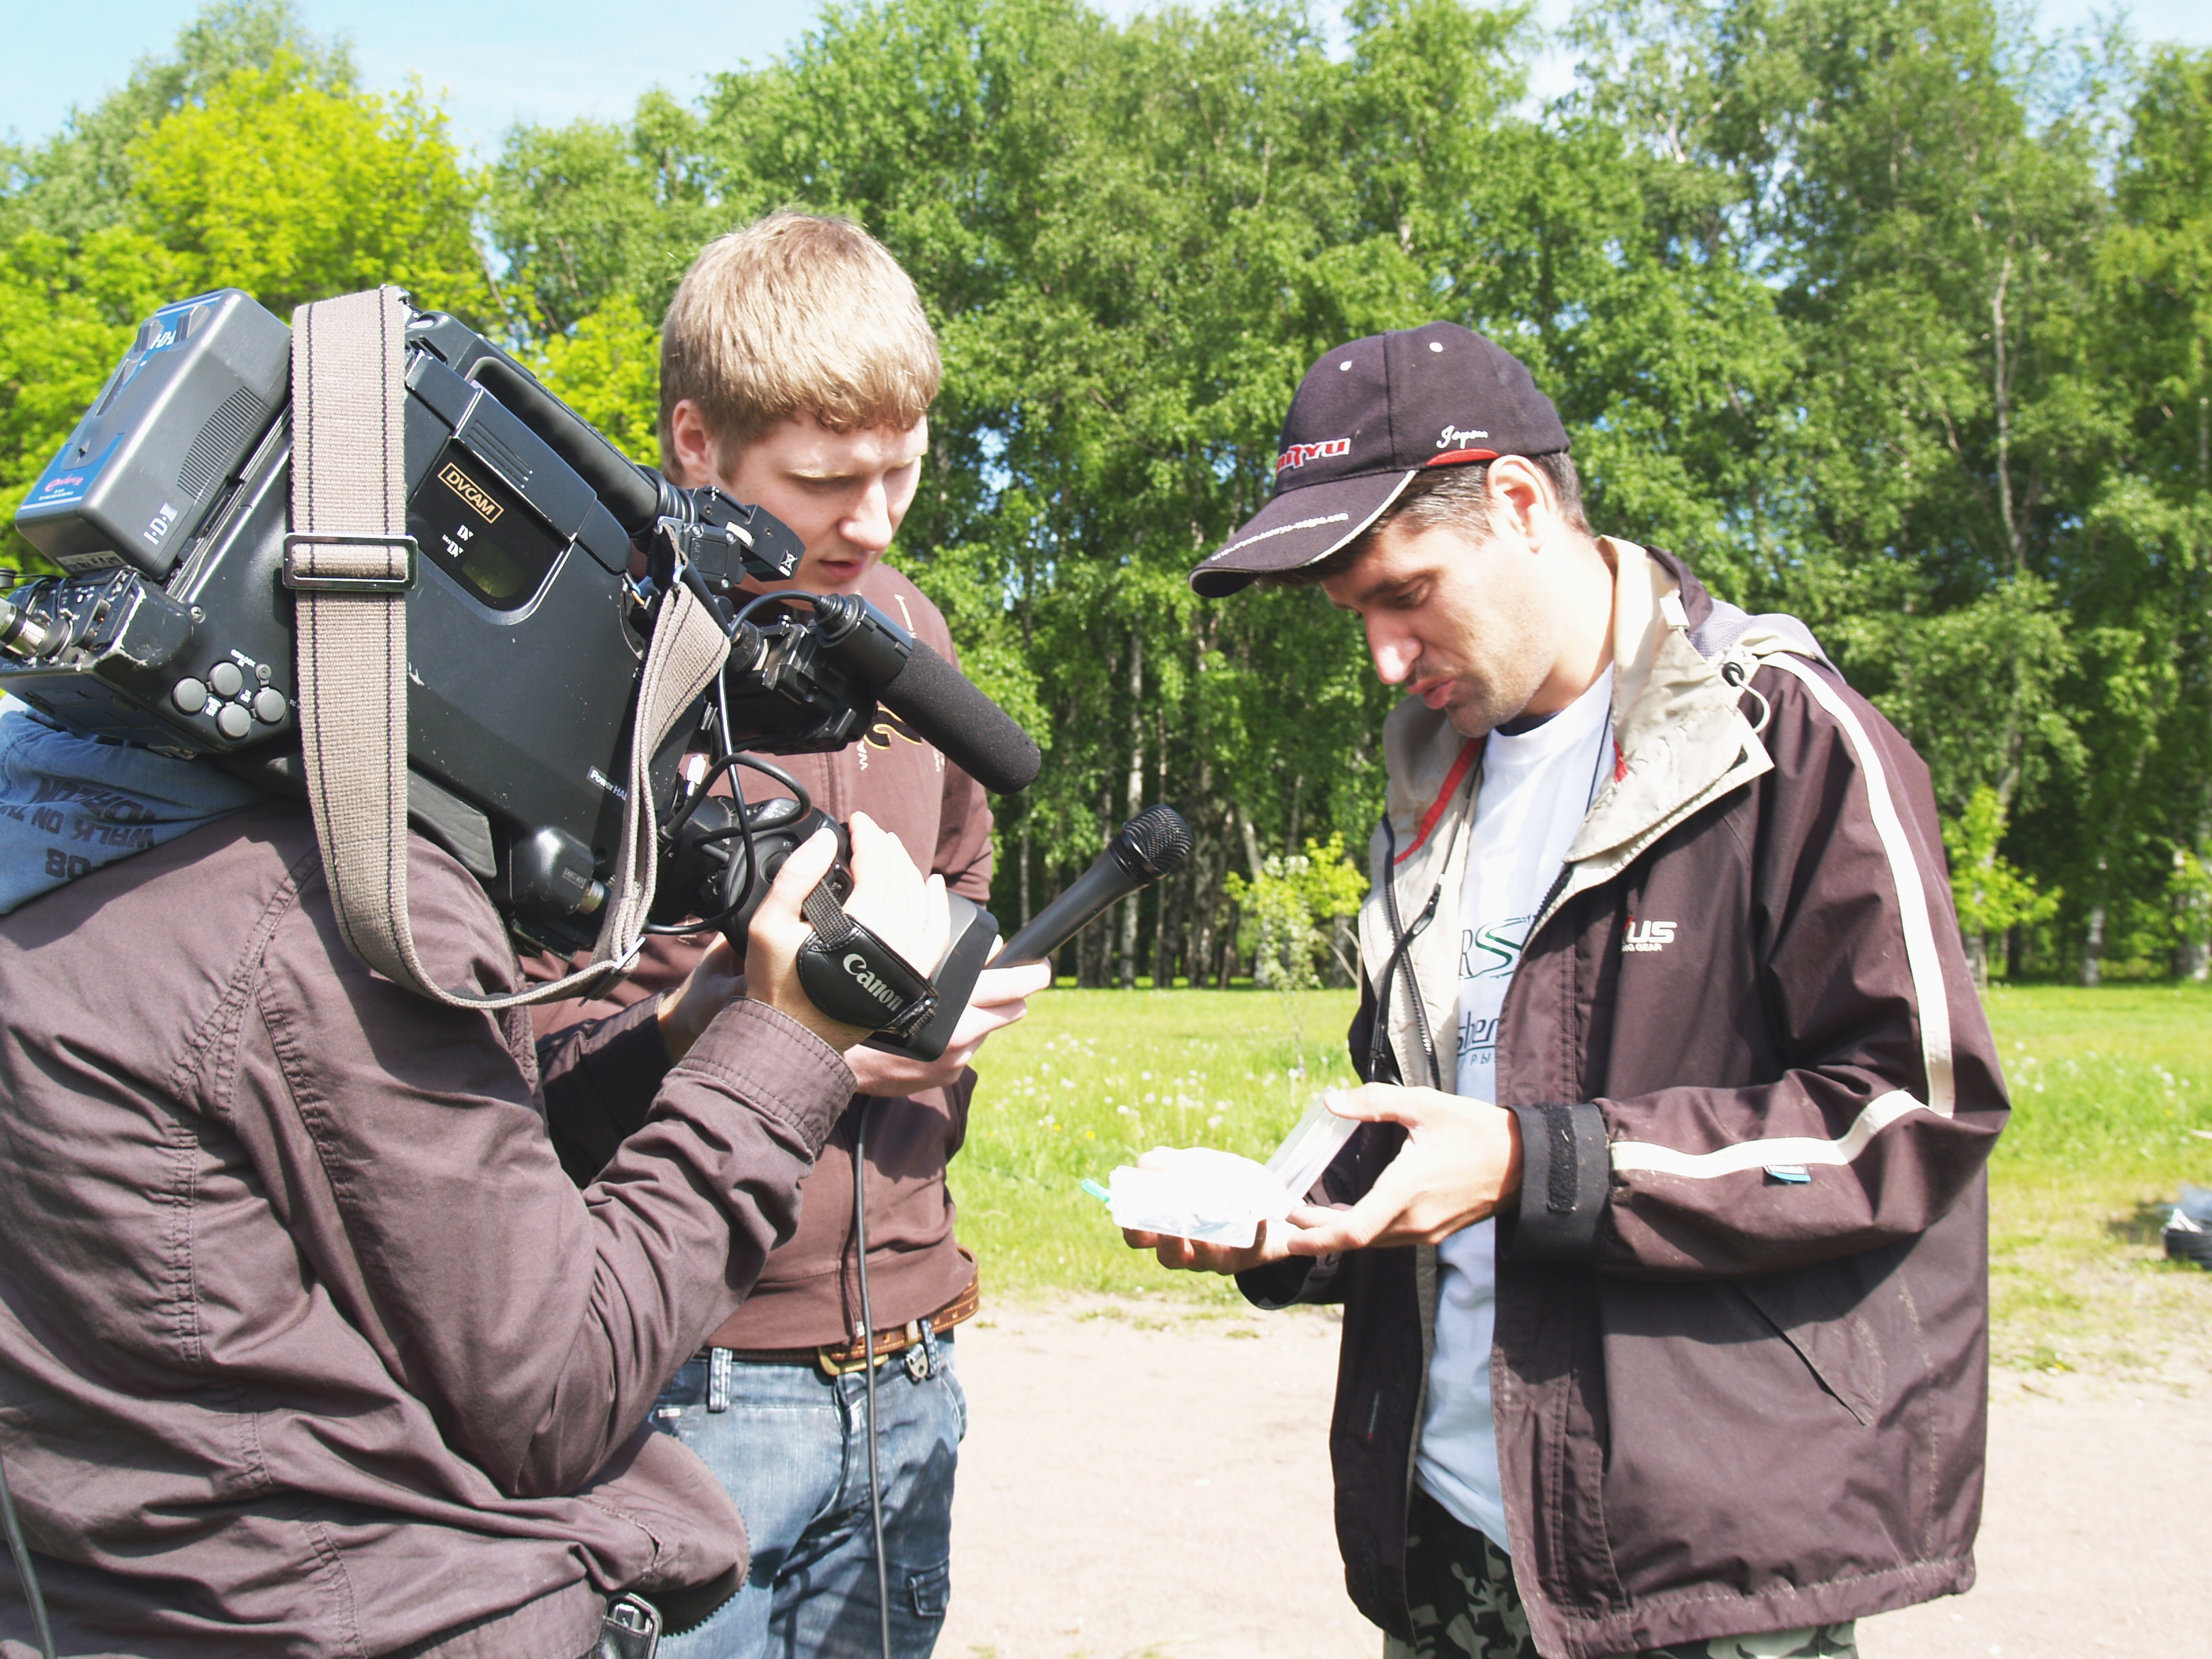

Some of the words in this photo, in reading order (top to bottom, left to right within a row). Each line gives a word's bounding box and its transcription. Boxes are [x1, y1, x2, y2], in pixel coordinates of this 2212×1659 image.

[446, 470, 495, 516] DVCAM
[32, 806, 64, 834] ON
[70, 819, 155, 848] WALK
[842, 953, 904, 1012] Canon
